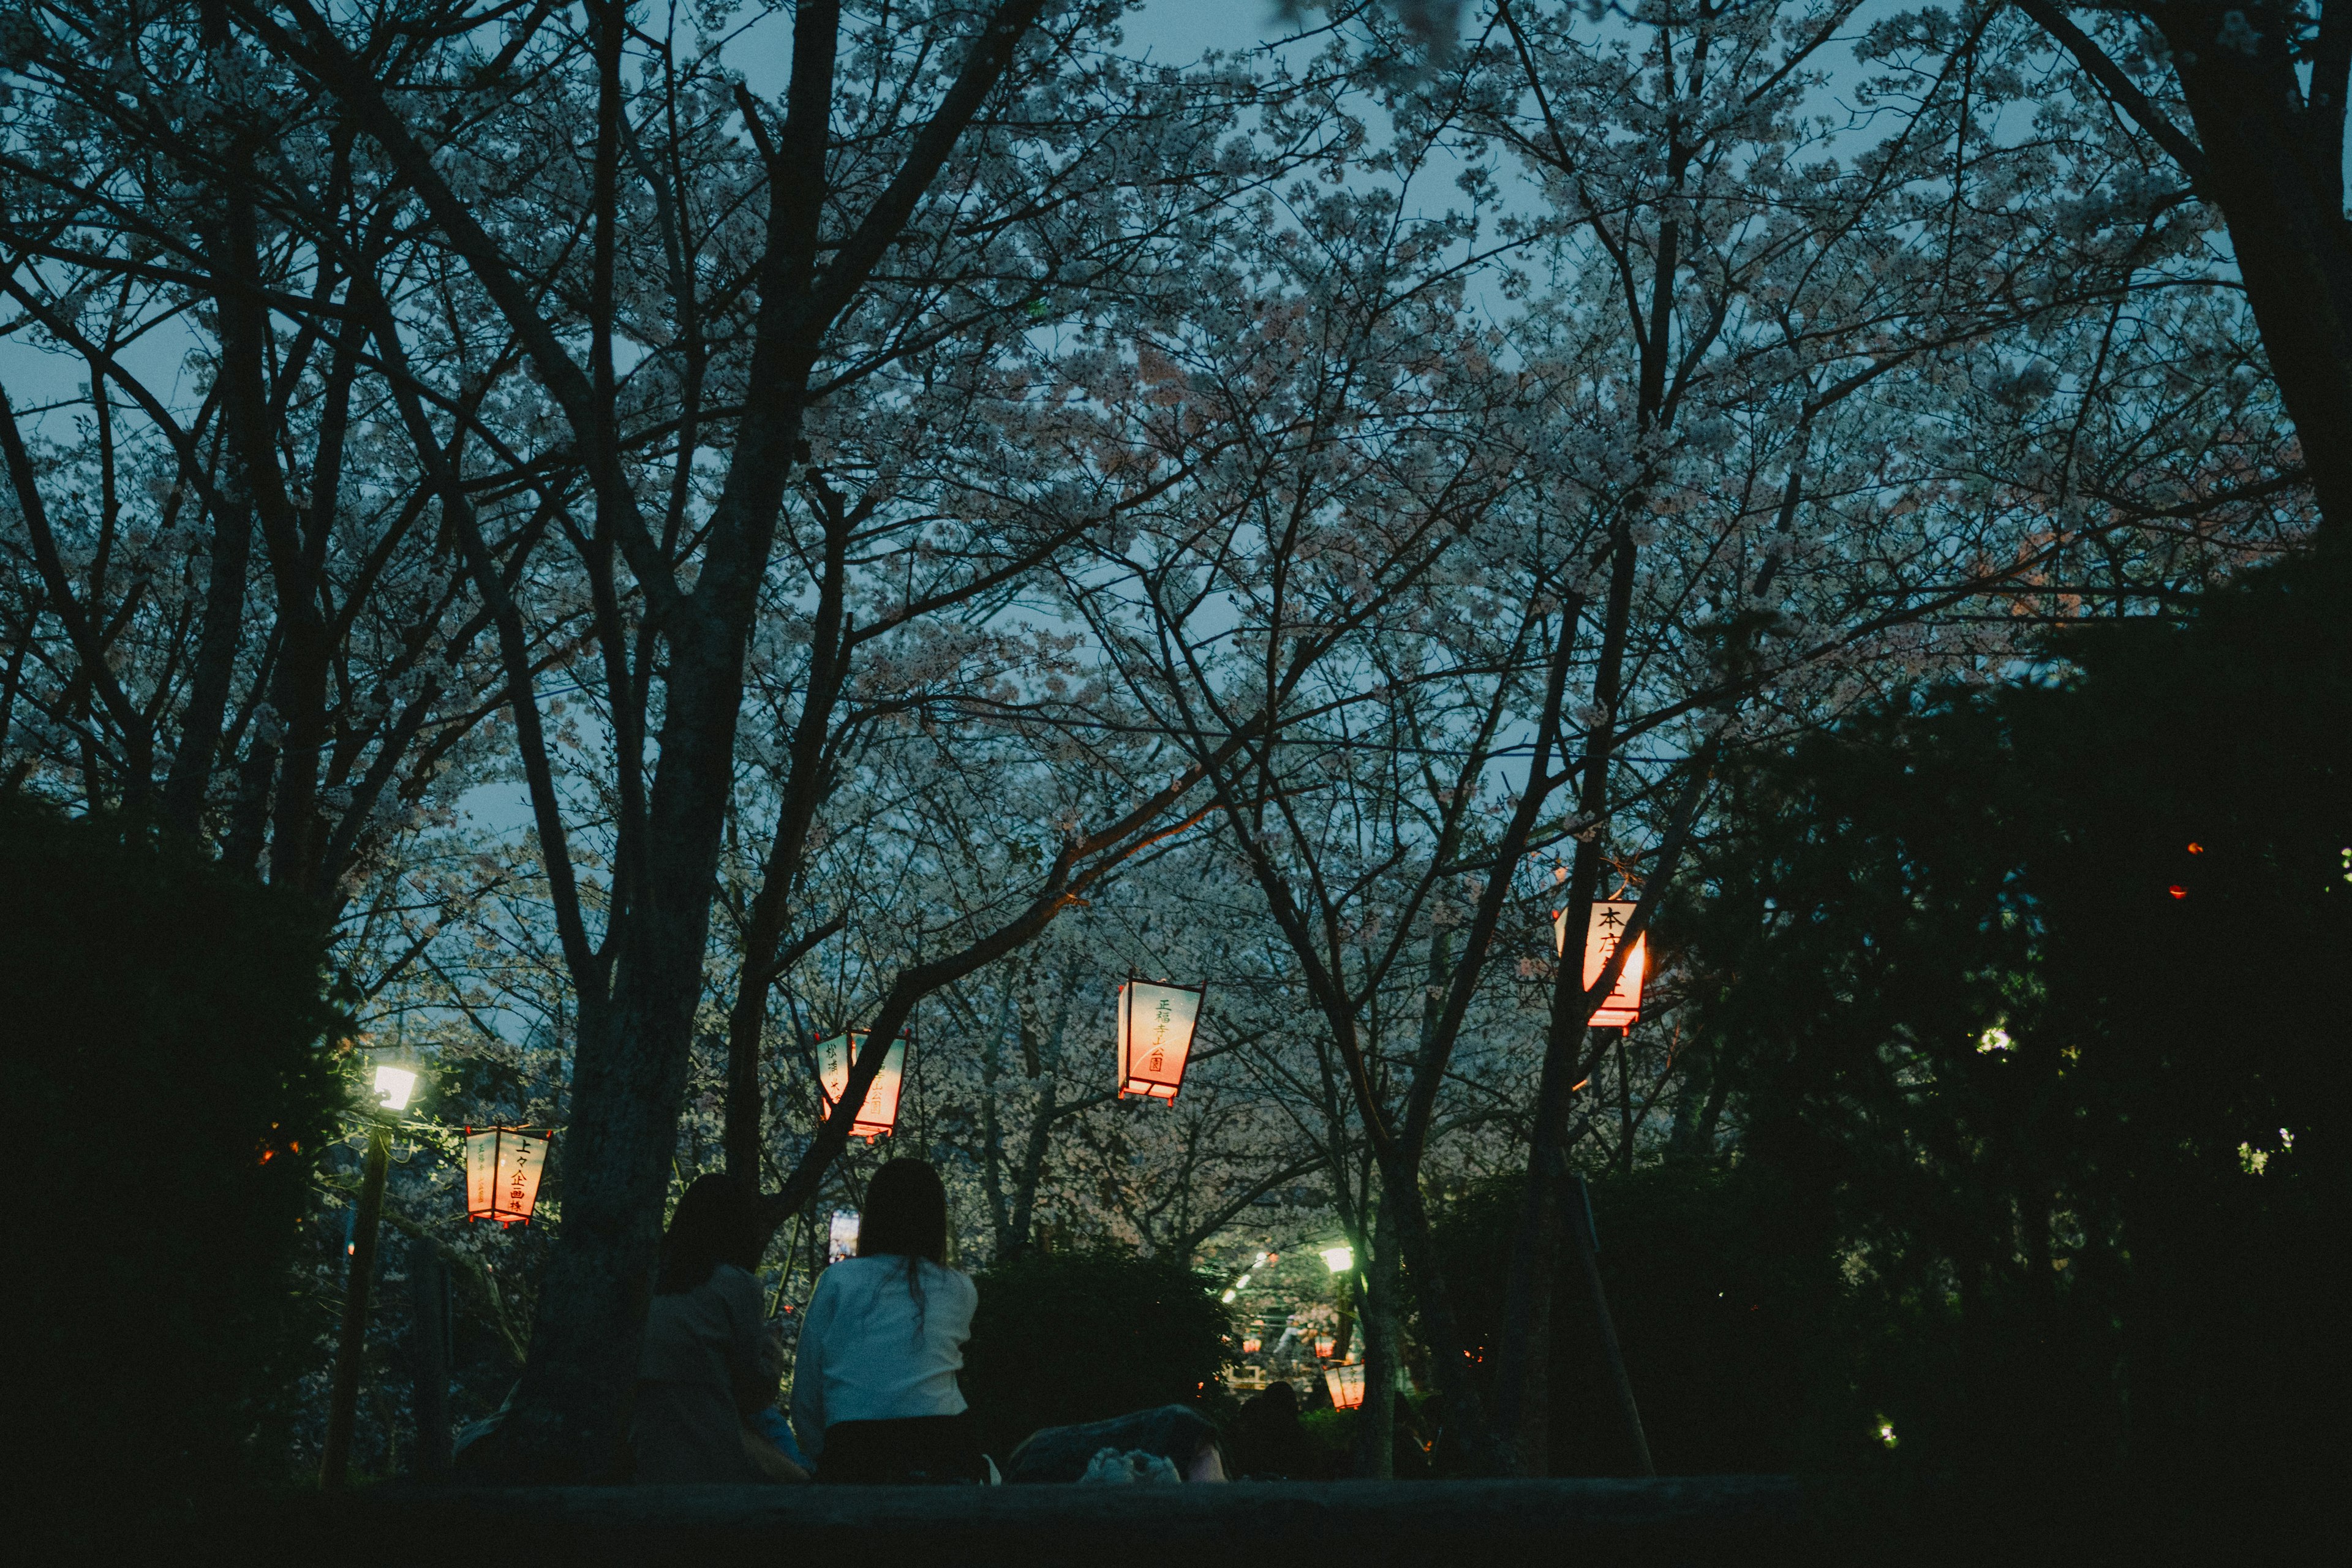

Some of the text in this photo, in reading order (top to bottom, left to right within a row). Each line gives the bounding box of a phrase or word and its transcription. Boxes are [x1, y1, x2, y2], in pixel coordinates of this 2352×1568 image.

[1149, 1000, 1172, 1072] 正福寺山公園
